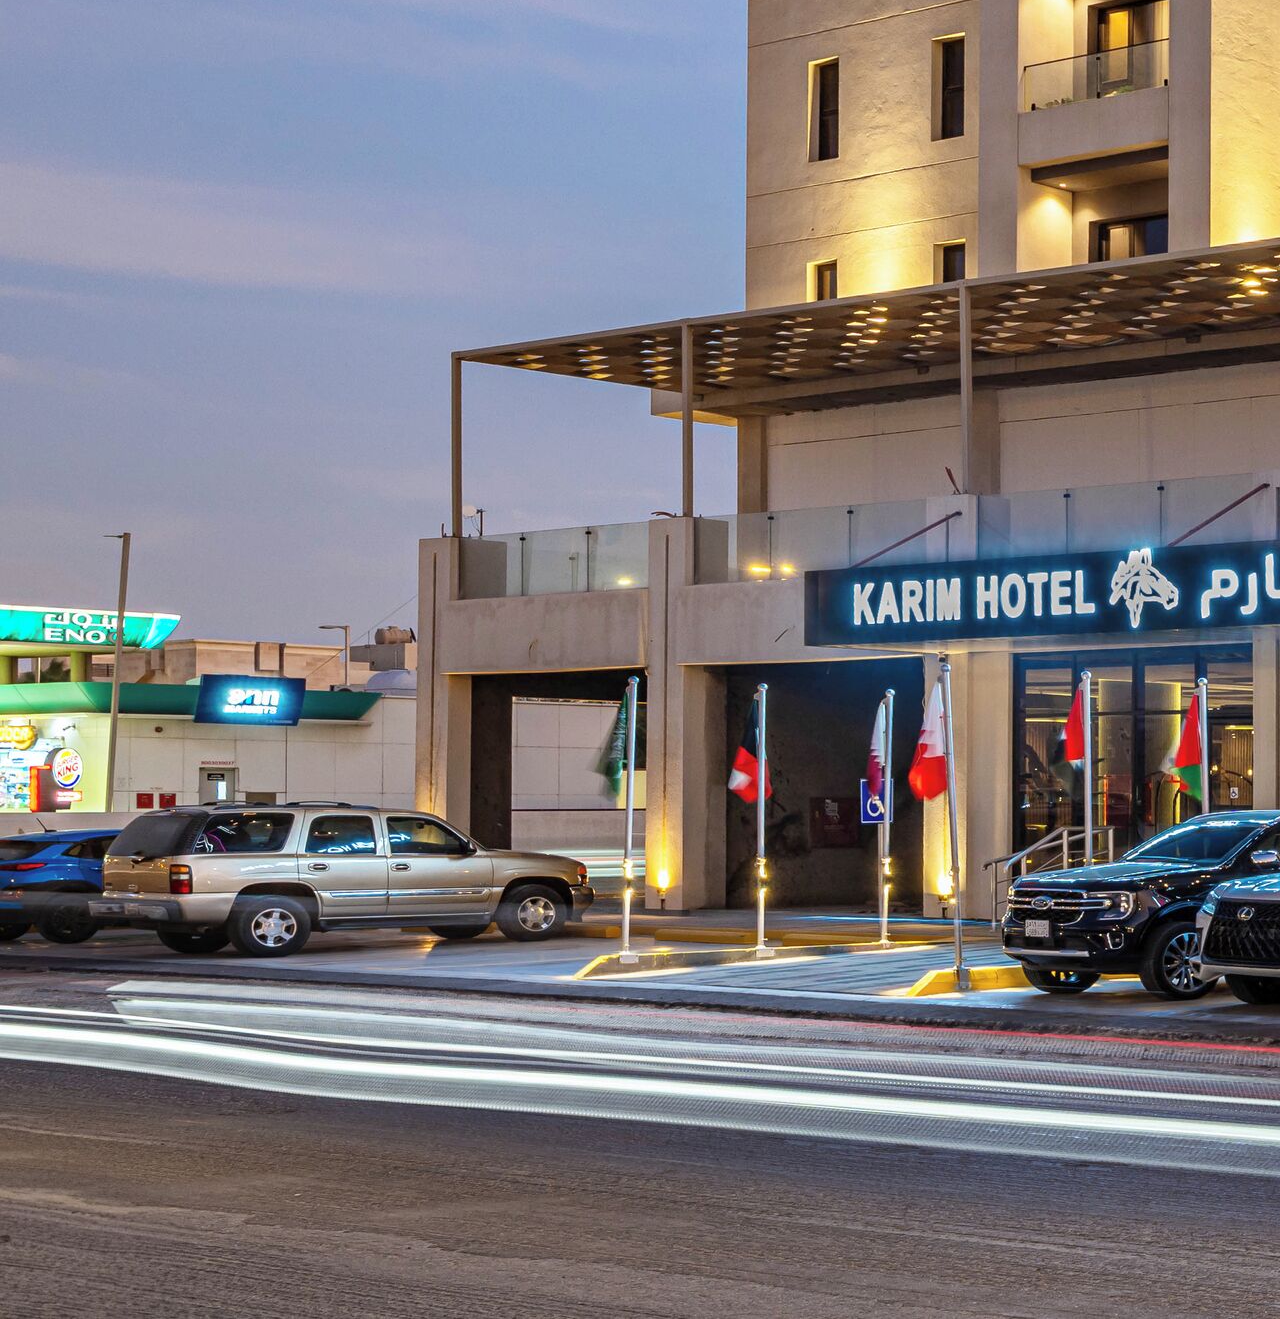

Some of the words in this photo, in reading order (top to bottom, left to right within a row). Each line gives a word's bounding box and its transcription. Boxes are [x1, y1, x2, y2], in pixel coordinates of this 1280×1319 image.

[853, 578, 961, 626] KARIM
[976, 569, 1096, 620] HOTEL
[57, 762, 79, 777] KING
